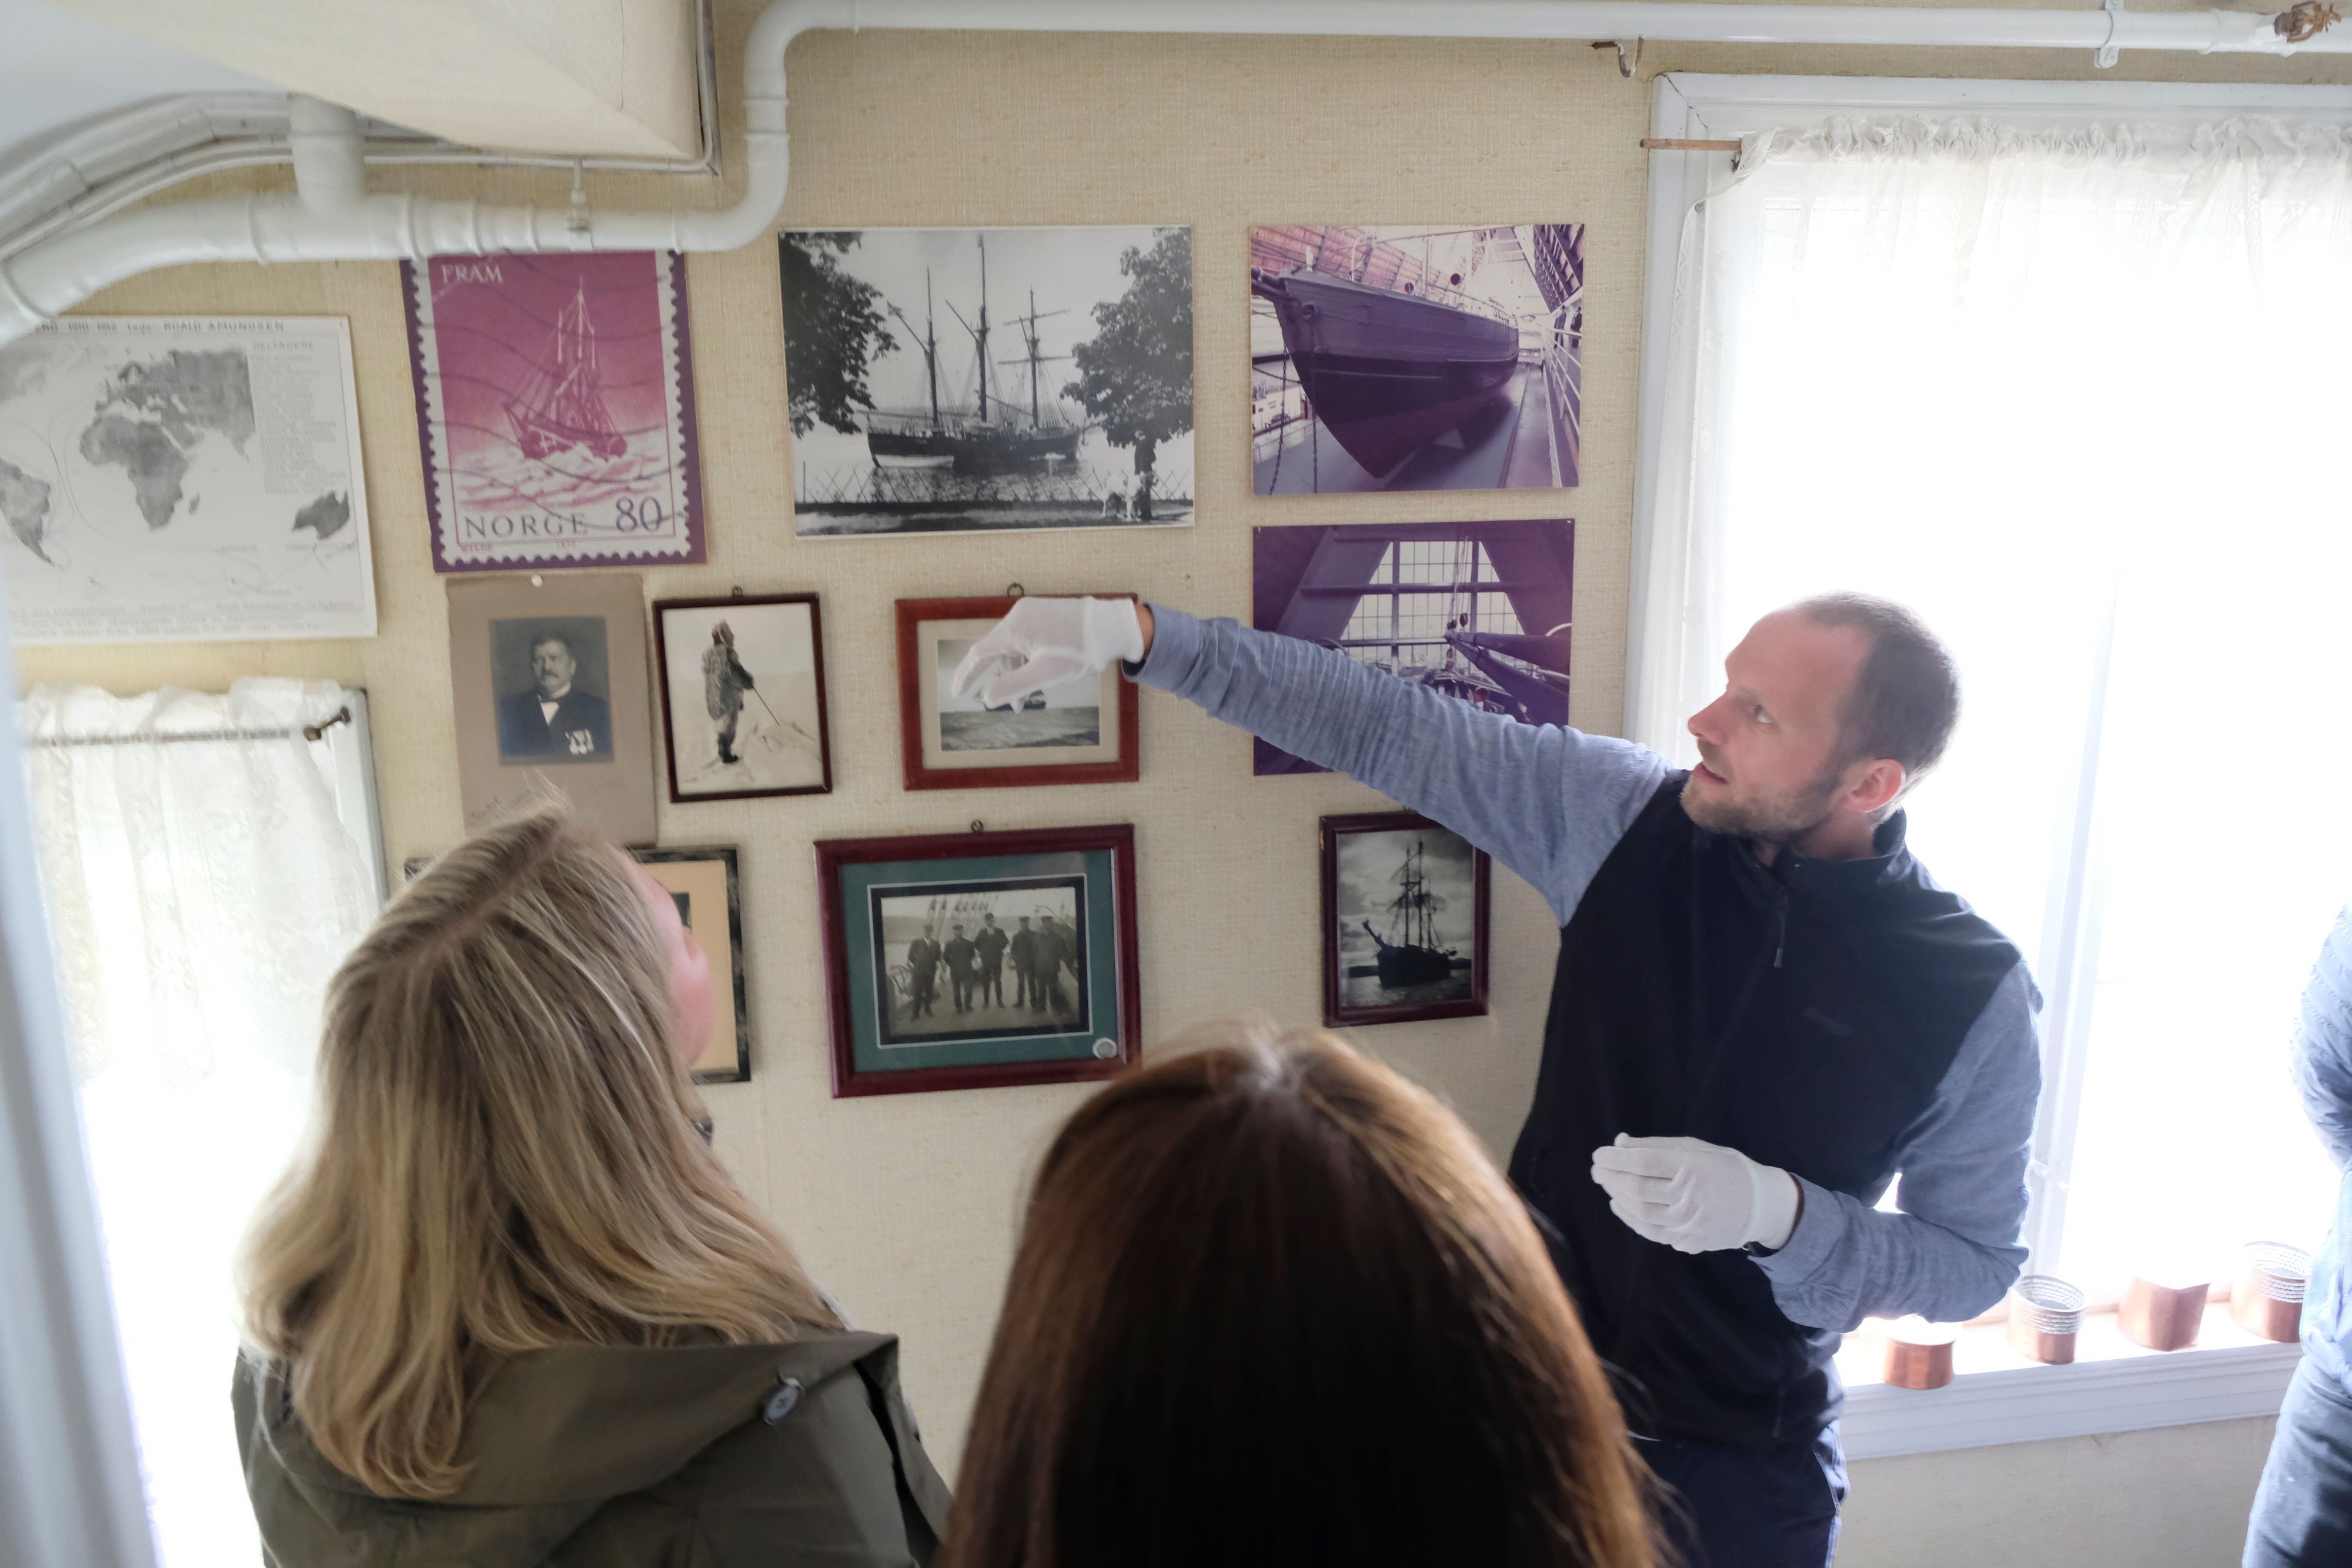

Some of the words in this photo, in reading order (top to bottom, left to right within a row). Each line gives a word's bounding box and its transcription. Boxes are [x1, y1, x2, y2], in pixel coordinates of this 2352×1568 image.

[442, 264, 504, 285] FRAM
[208, 320, 284, 333] AMUNDSEN
[463, 512, 589, 539] NORGE
[615, 496, 663, 533] 80
